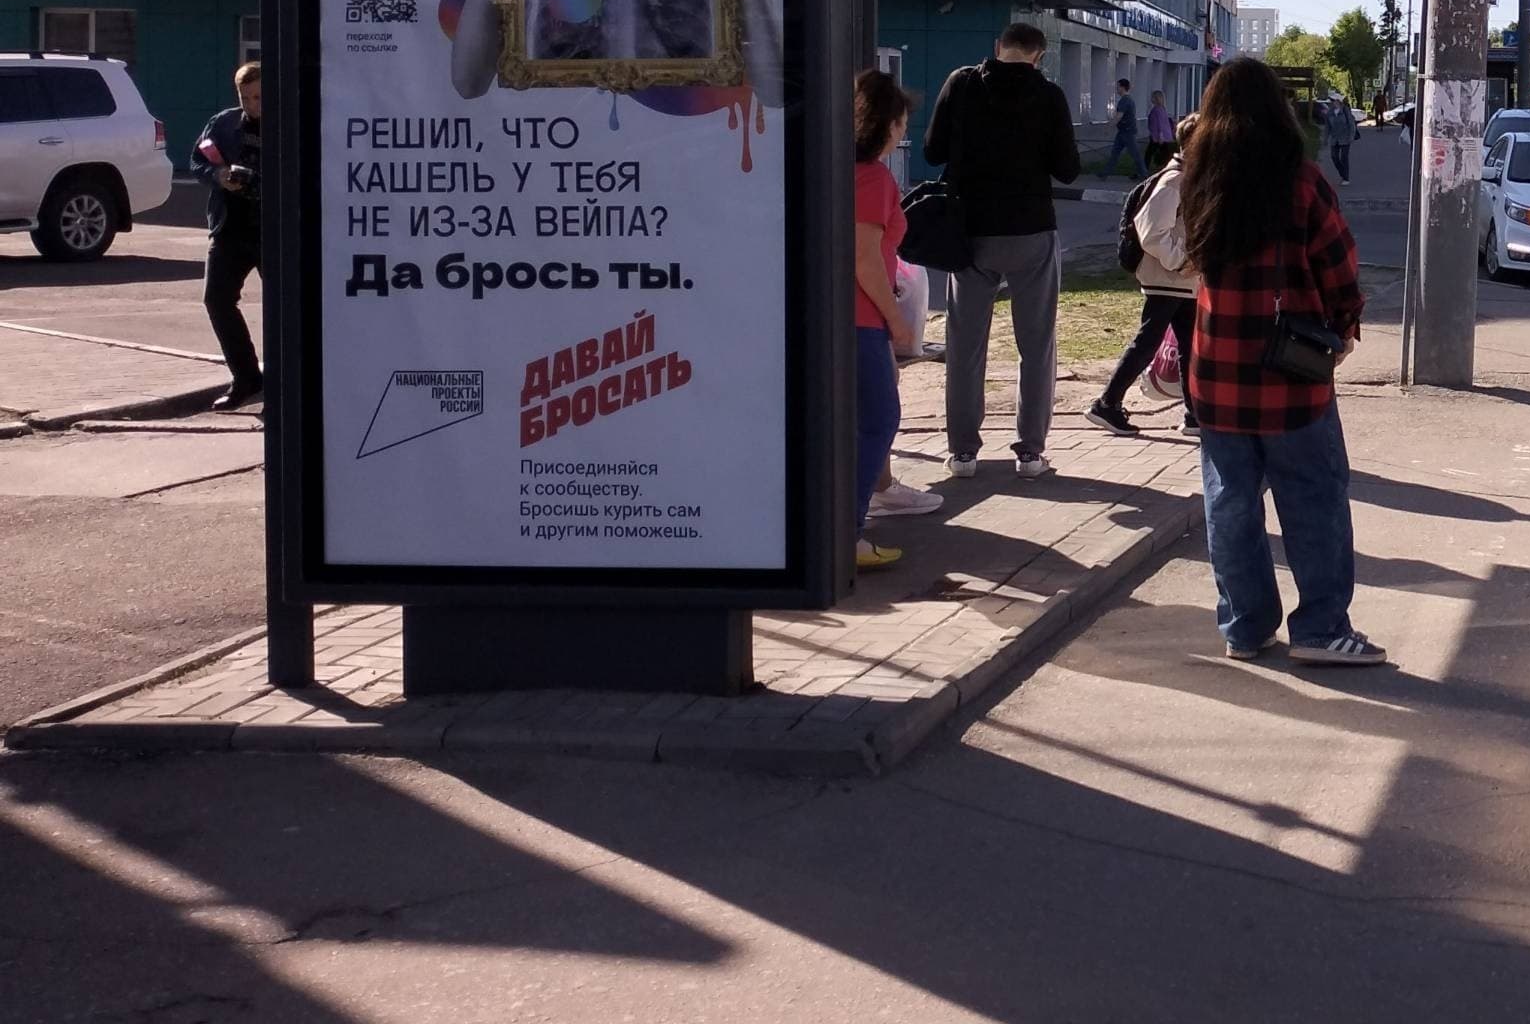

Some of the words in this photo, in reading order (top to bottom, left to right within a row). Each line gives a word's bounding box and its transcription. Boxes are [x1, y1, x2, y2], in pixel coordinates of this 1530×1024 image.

[347, 33, 392, 41] переходи
[347, 117, 483, 152] РЕШИЛ,
[502, 117, 579, 149] ЧТО
[347, 161, 494, 193] КАШЕЛЬ
[512, 161, 533, 193] У
[348, 205, 389, 237] НЕ
[411, 205, 516, 237] ИЗ-ЗА
[536, 199, 668, 237] ВЕЙПА?
[346, 254, 423, 297] Да
[436, 252, 599, 299] брось
[610, 261, 694, 290] ты.
[521, 309, 655, 406] ДАВАЙ
[396, 374, 480, 387] НАЦИОНАЛЬНЫЕ
[432, 387, 480, 399] ПРОЕКТЫ
[520, 351, 692, 448] БРОСАТЬ
[441, 400, 480, 412] РОССИИ
[520, 459, 658, 476] Присоединяйся
[520, 482, 530, 496] к
[534, 479, 643, 499] сообществу.
[520, 501, 599, 517] Бросишь
[604, 504, 662, 520] курить
[667, 504, 701, 517] сам
[520, 525, 530, 537] и
[536, 524, 599, 541] другим
[604, 524, 702, 540] поможешь.
